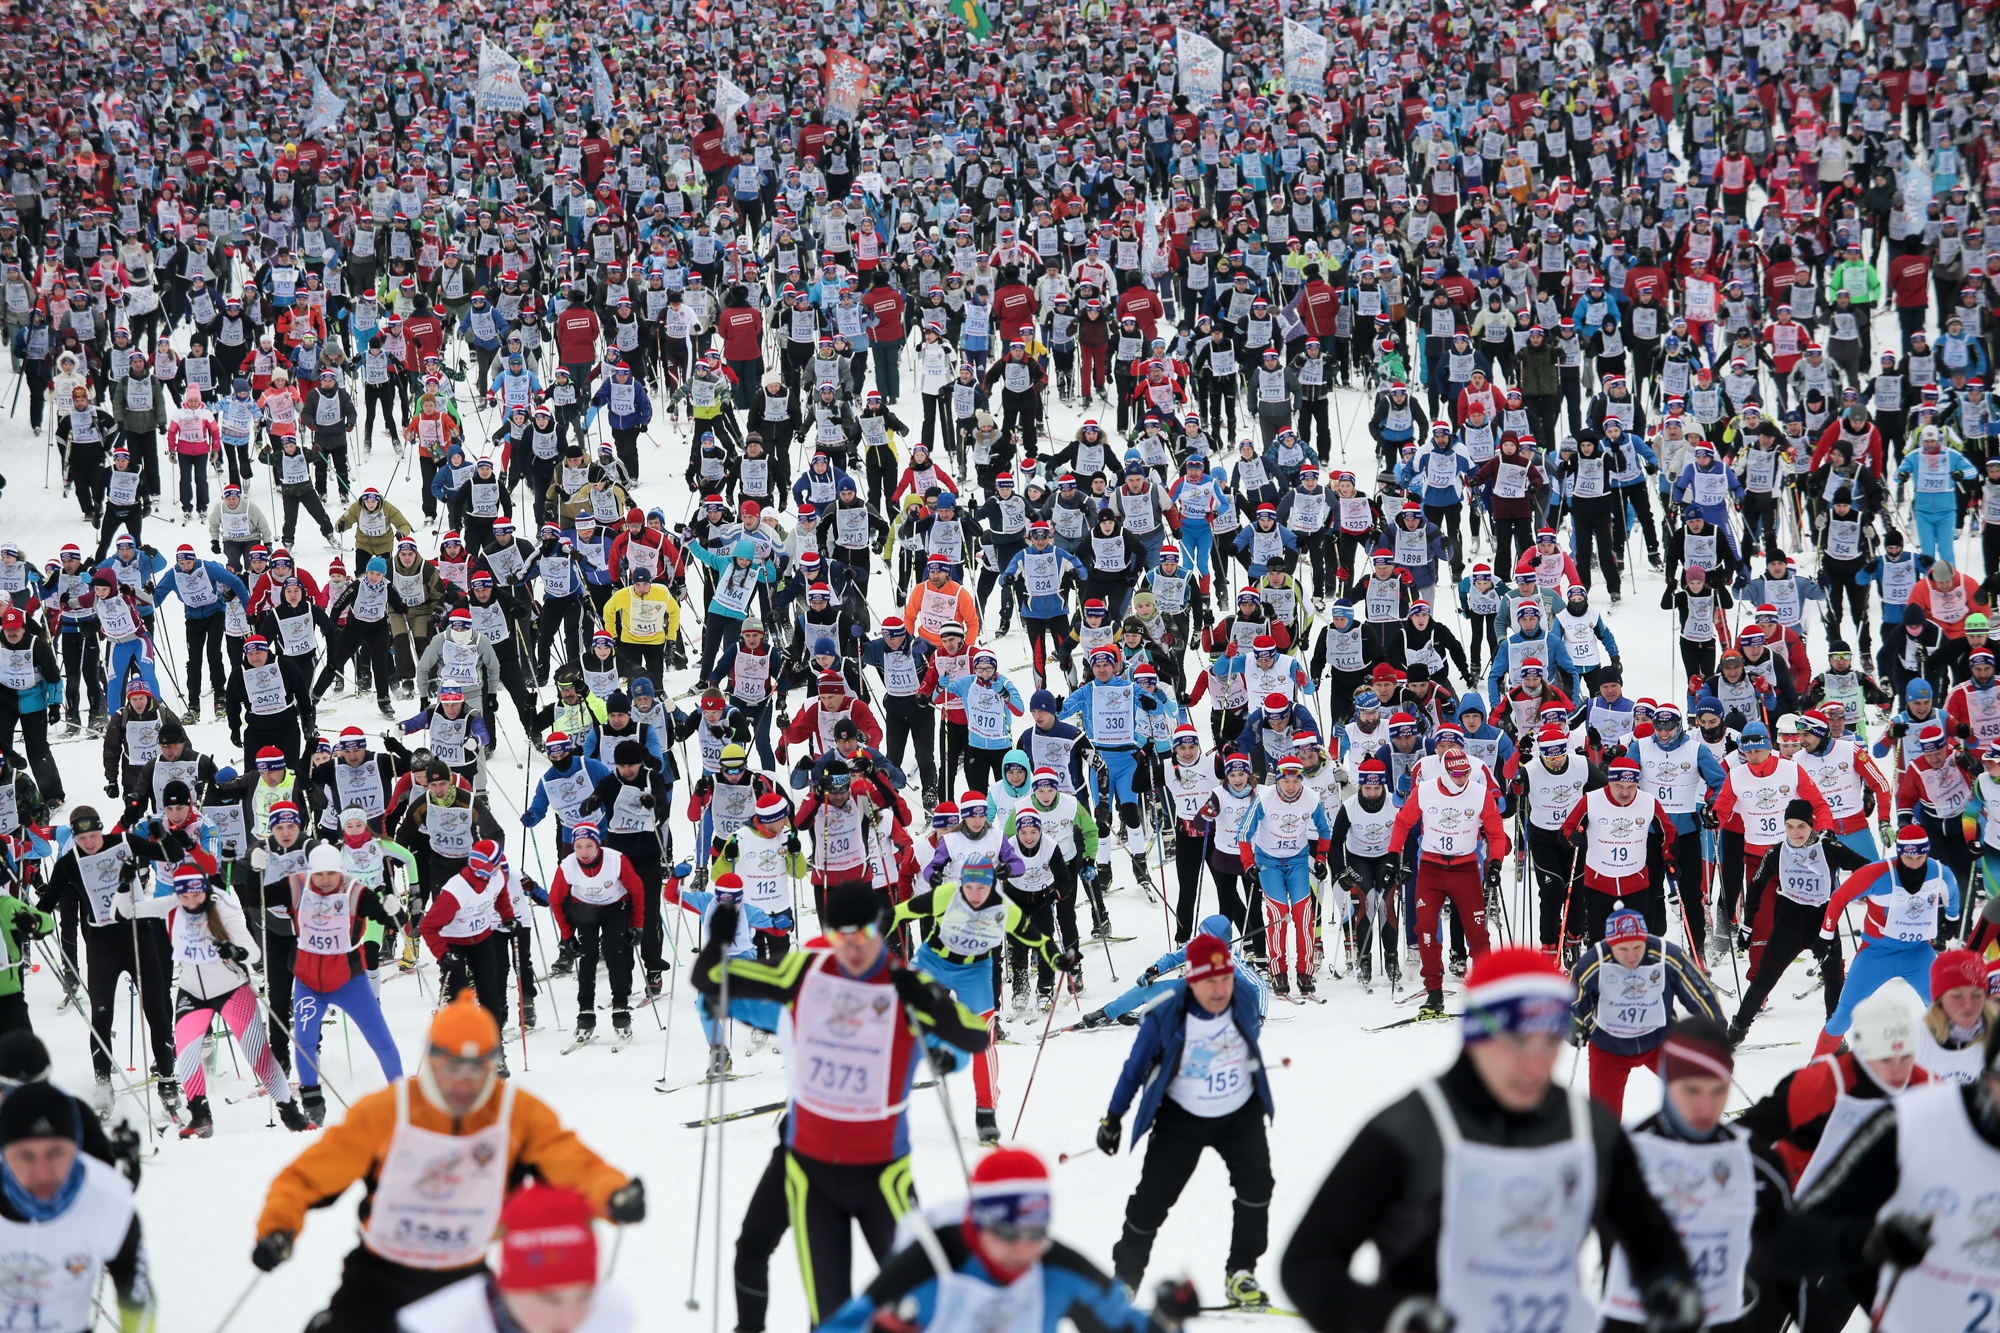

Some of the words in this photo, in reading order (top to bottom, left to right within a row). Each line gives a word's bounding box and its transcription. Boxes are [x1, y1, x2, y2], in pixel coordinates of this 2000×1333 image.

[1501, 487, 1516, 497] 304
[1580, 481, 1595, 490] 440
[1129, 518, 1147, 528] 1555
[1403, 554, 1421, 563] 1898
[545, 579, 564, 588] 1366
[1035, 580, 1051, 590] 824
[1891, 588, 1907, 598] 853
[891, 674, 911, 685] 3311
[972, 715, 996, 728] 1810
[1105, 717, 1125, 729] 330
[1658, 786, 1673, 800] 61
[1184, 798, 1198, 811] 21
[1827, 795, 1843, 808] 32
[1946, 790, 1965, 810] 701
[1553, 809, 1567, 821] 64
[1760, 818, 1776, 831] 36
[830, 838, 849, 854] 630
[1439, 837, 1453, 851] 18
[1611, 847, 1628, 861] 19
[757, 881, 776, 894] 112
[1788, 877, 1819, 892] 9951
[308, 934, 339, 950] 4591
[184, 945, 216, 960] 4716
[1618, 1008, 1647, 1022] 497
[810, 1056, 868, 1094] 7373
[1205, 1071, 1238, 1091] 155
[1495, 1292, 1571, 1333] 322
